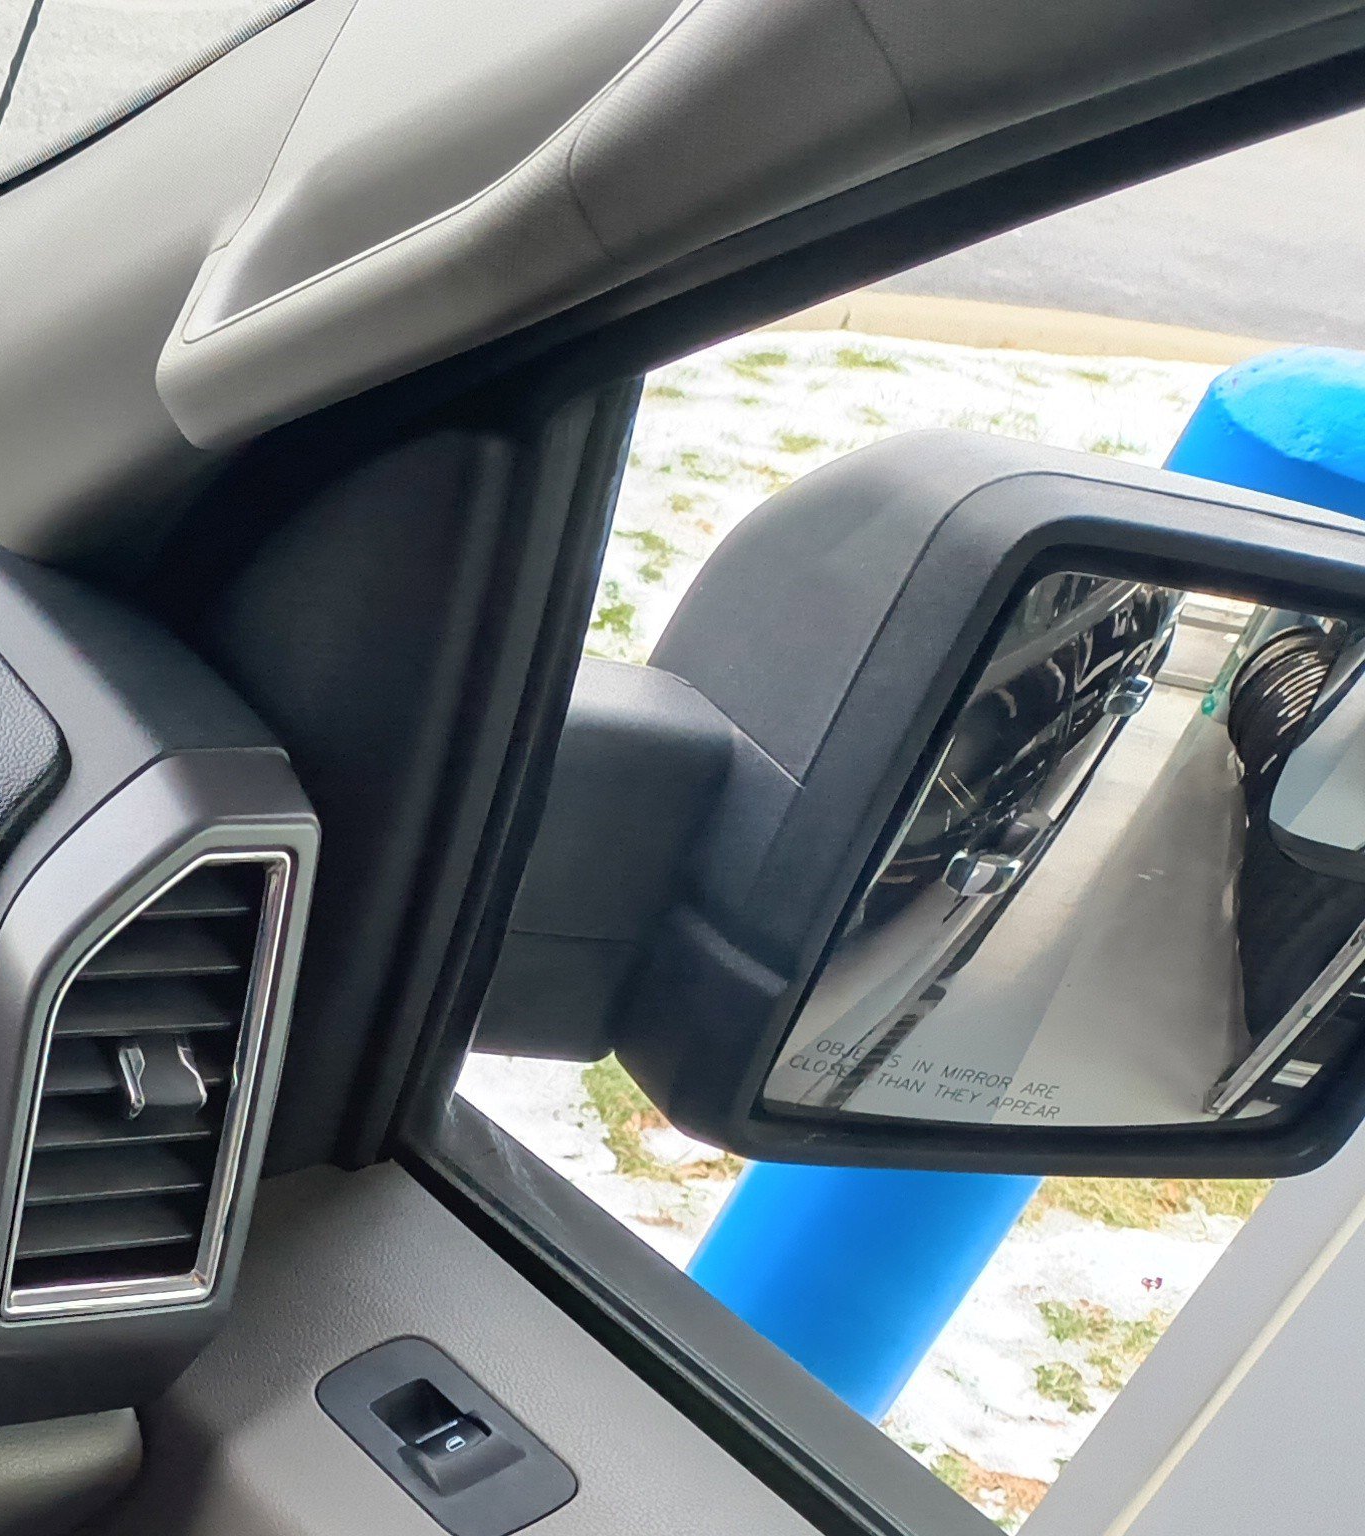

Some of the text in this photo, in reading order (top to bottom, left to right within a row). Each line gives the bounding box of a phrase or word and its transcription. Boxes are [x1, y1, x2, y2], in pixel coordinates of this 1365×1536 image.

[789, 1054, 1061, 1120] CLOSE THAN THEY APPEAR
[816, 1039, 1060, 1100] OBJES IN MIRROR ARE
